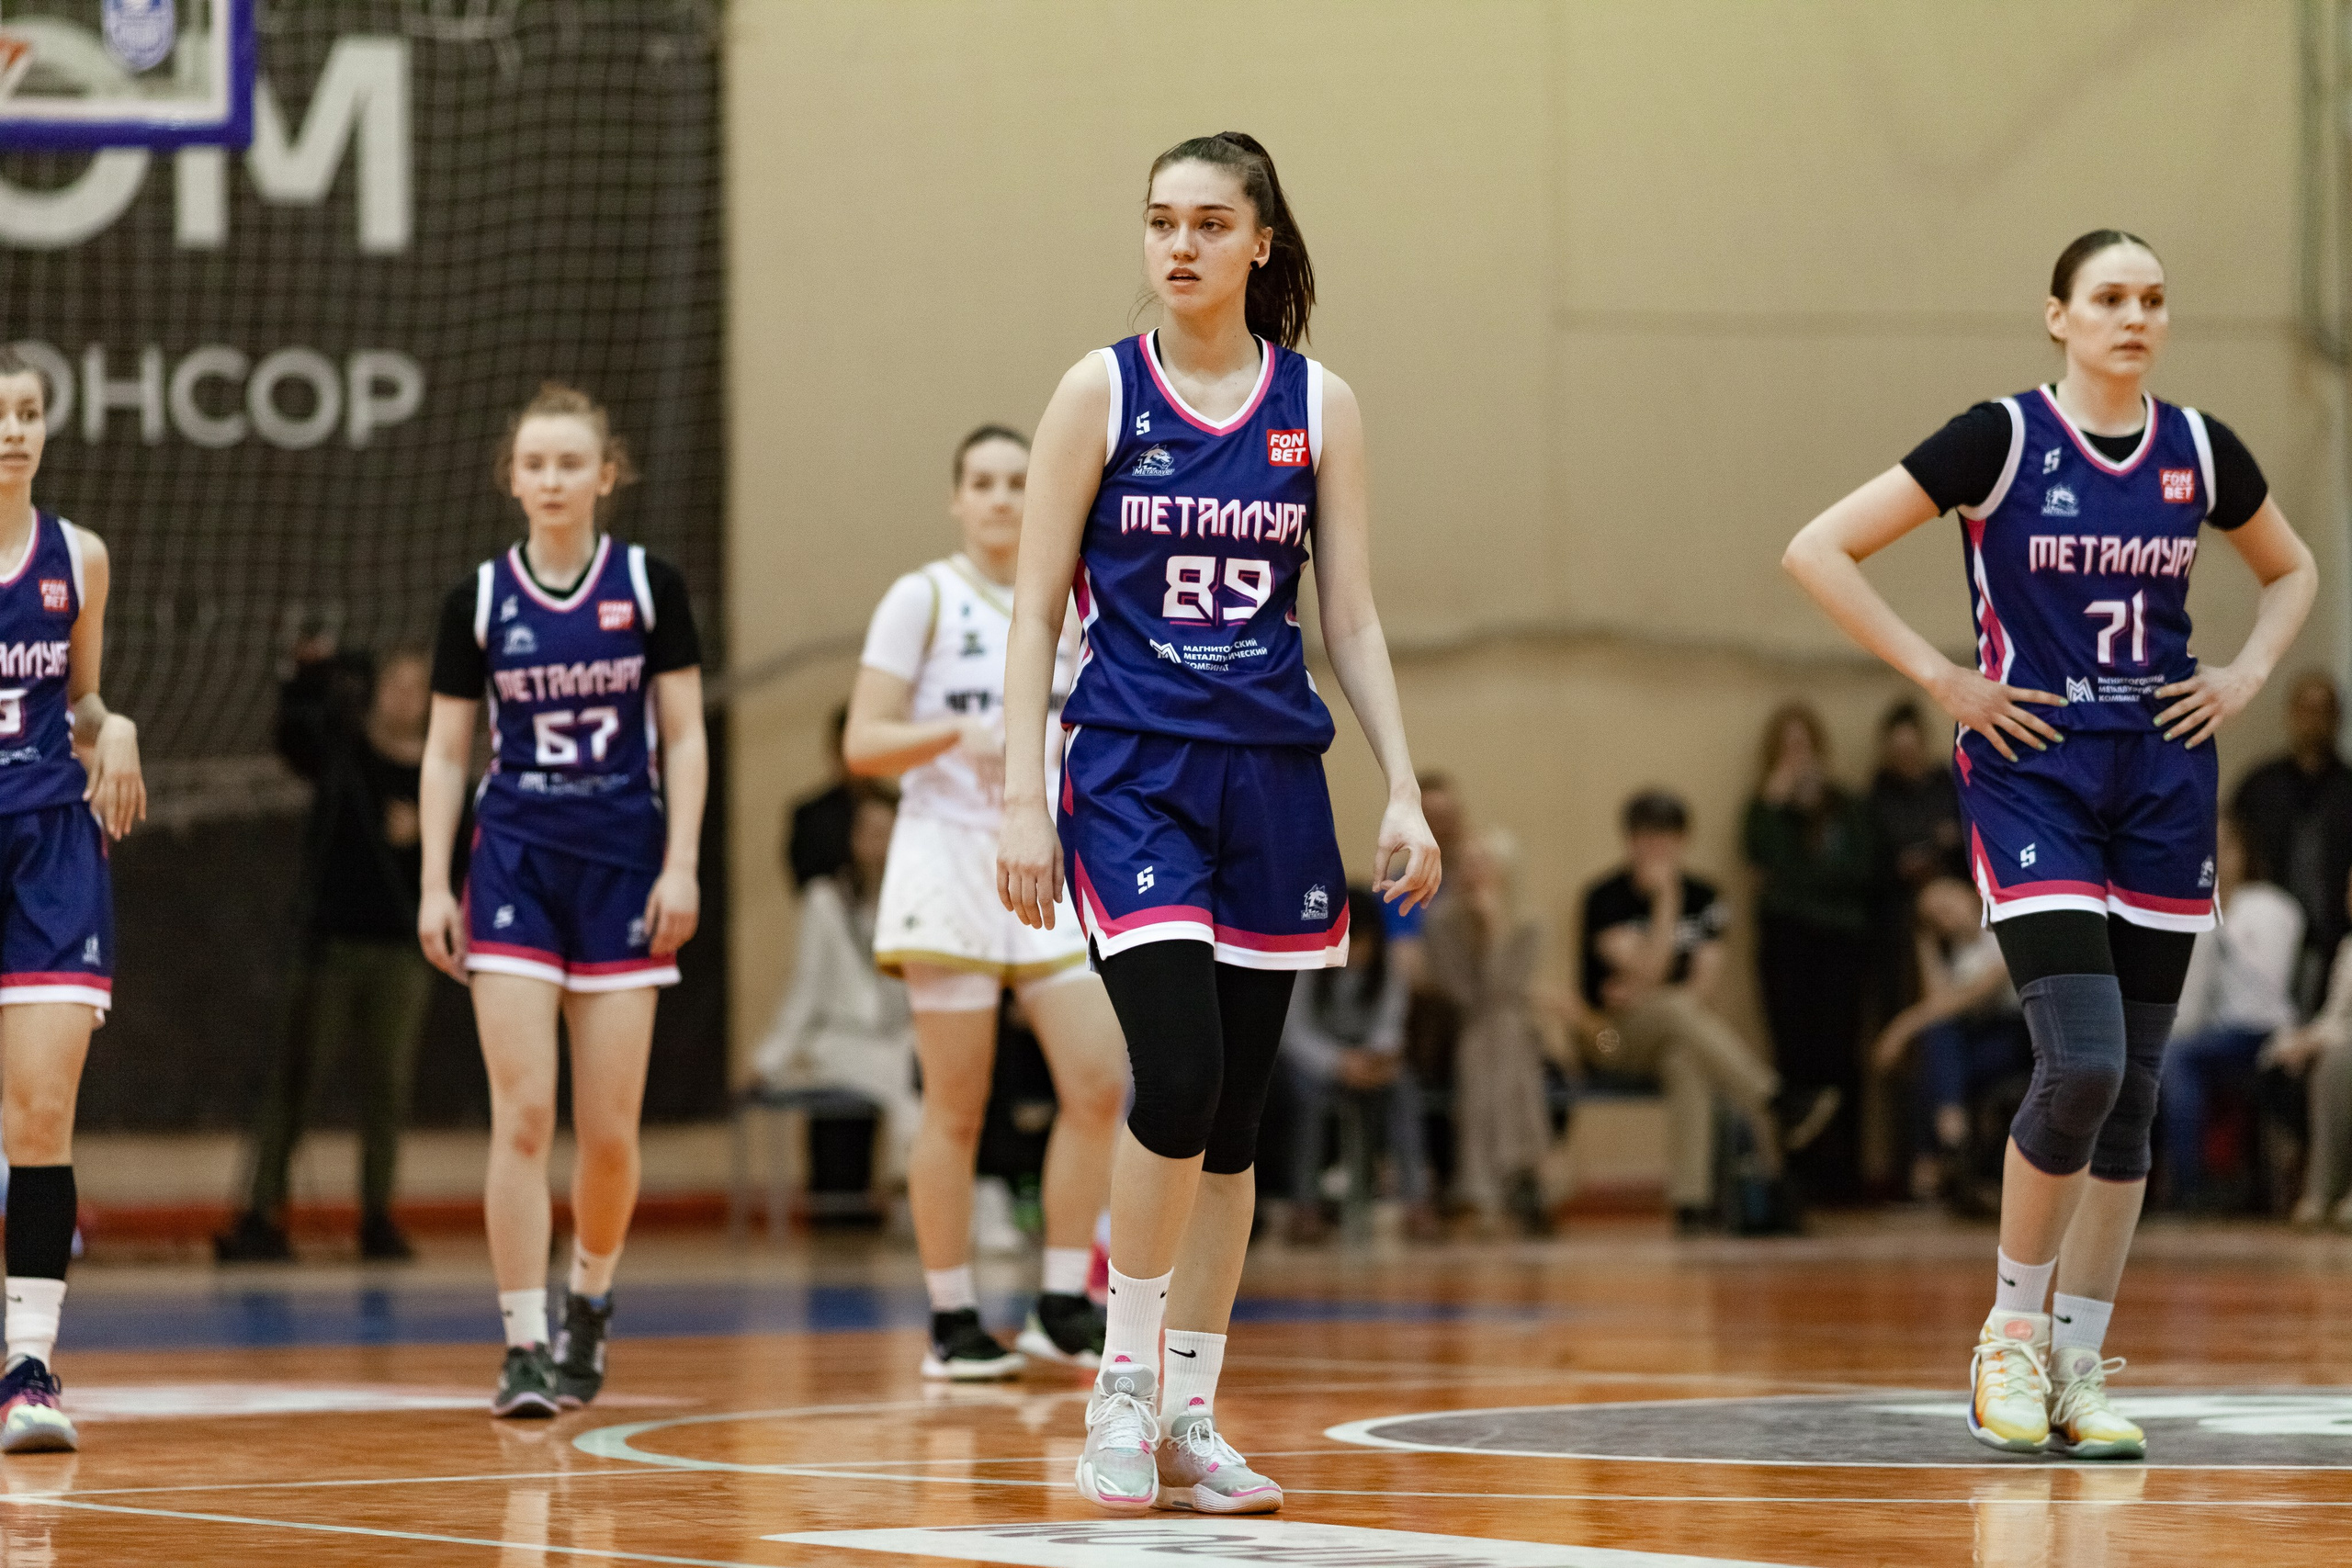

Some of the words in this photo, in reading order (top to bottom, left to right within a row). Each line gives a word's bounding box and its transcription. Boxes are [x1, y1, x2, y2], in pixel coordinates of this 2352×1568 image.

[1270, 433, 1305, 448] FON
[1271, 447, 1306, 463] BET
[2164, 485, 2193, 500] BET
[1121, 495, 1306, 547] МЕТАЛЛУРГ
[1162, 555, 1274, 626] 89
[1182, 637, 1258, 653] МАГНИТОСКИЙ
[2083, 589, 2148, 667] 71
[533, 705, 620, 766] 67
